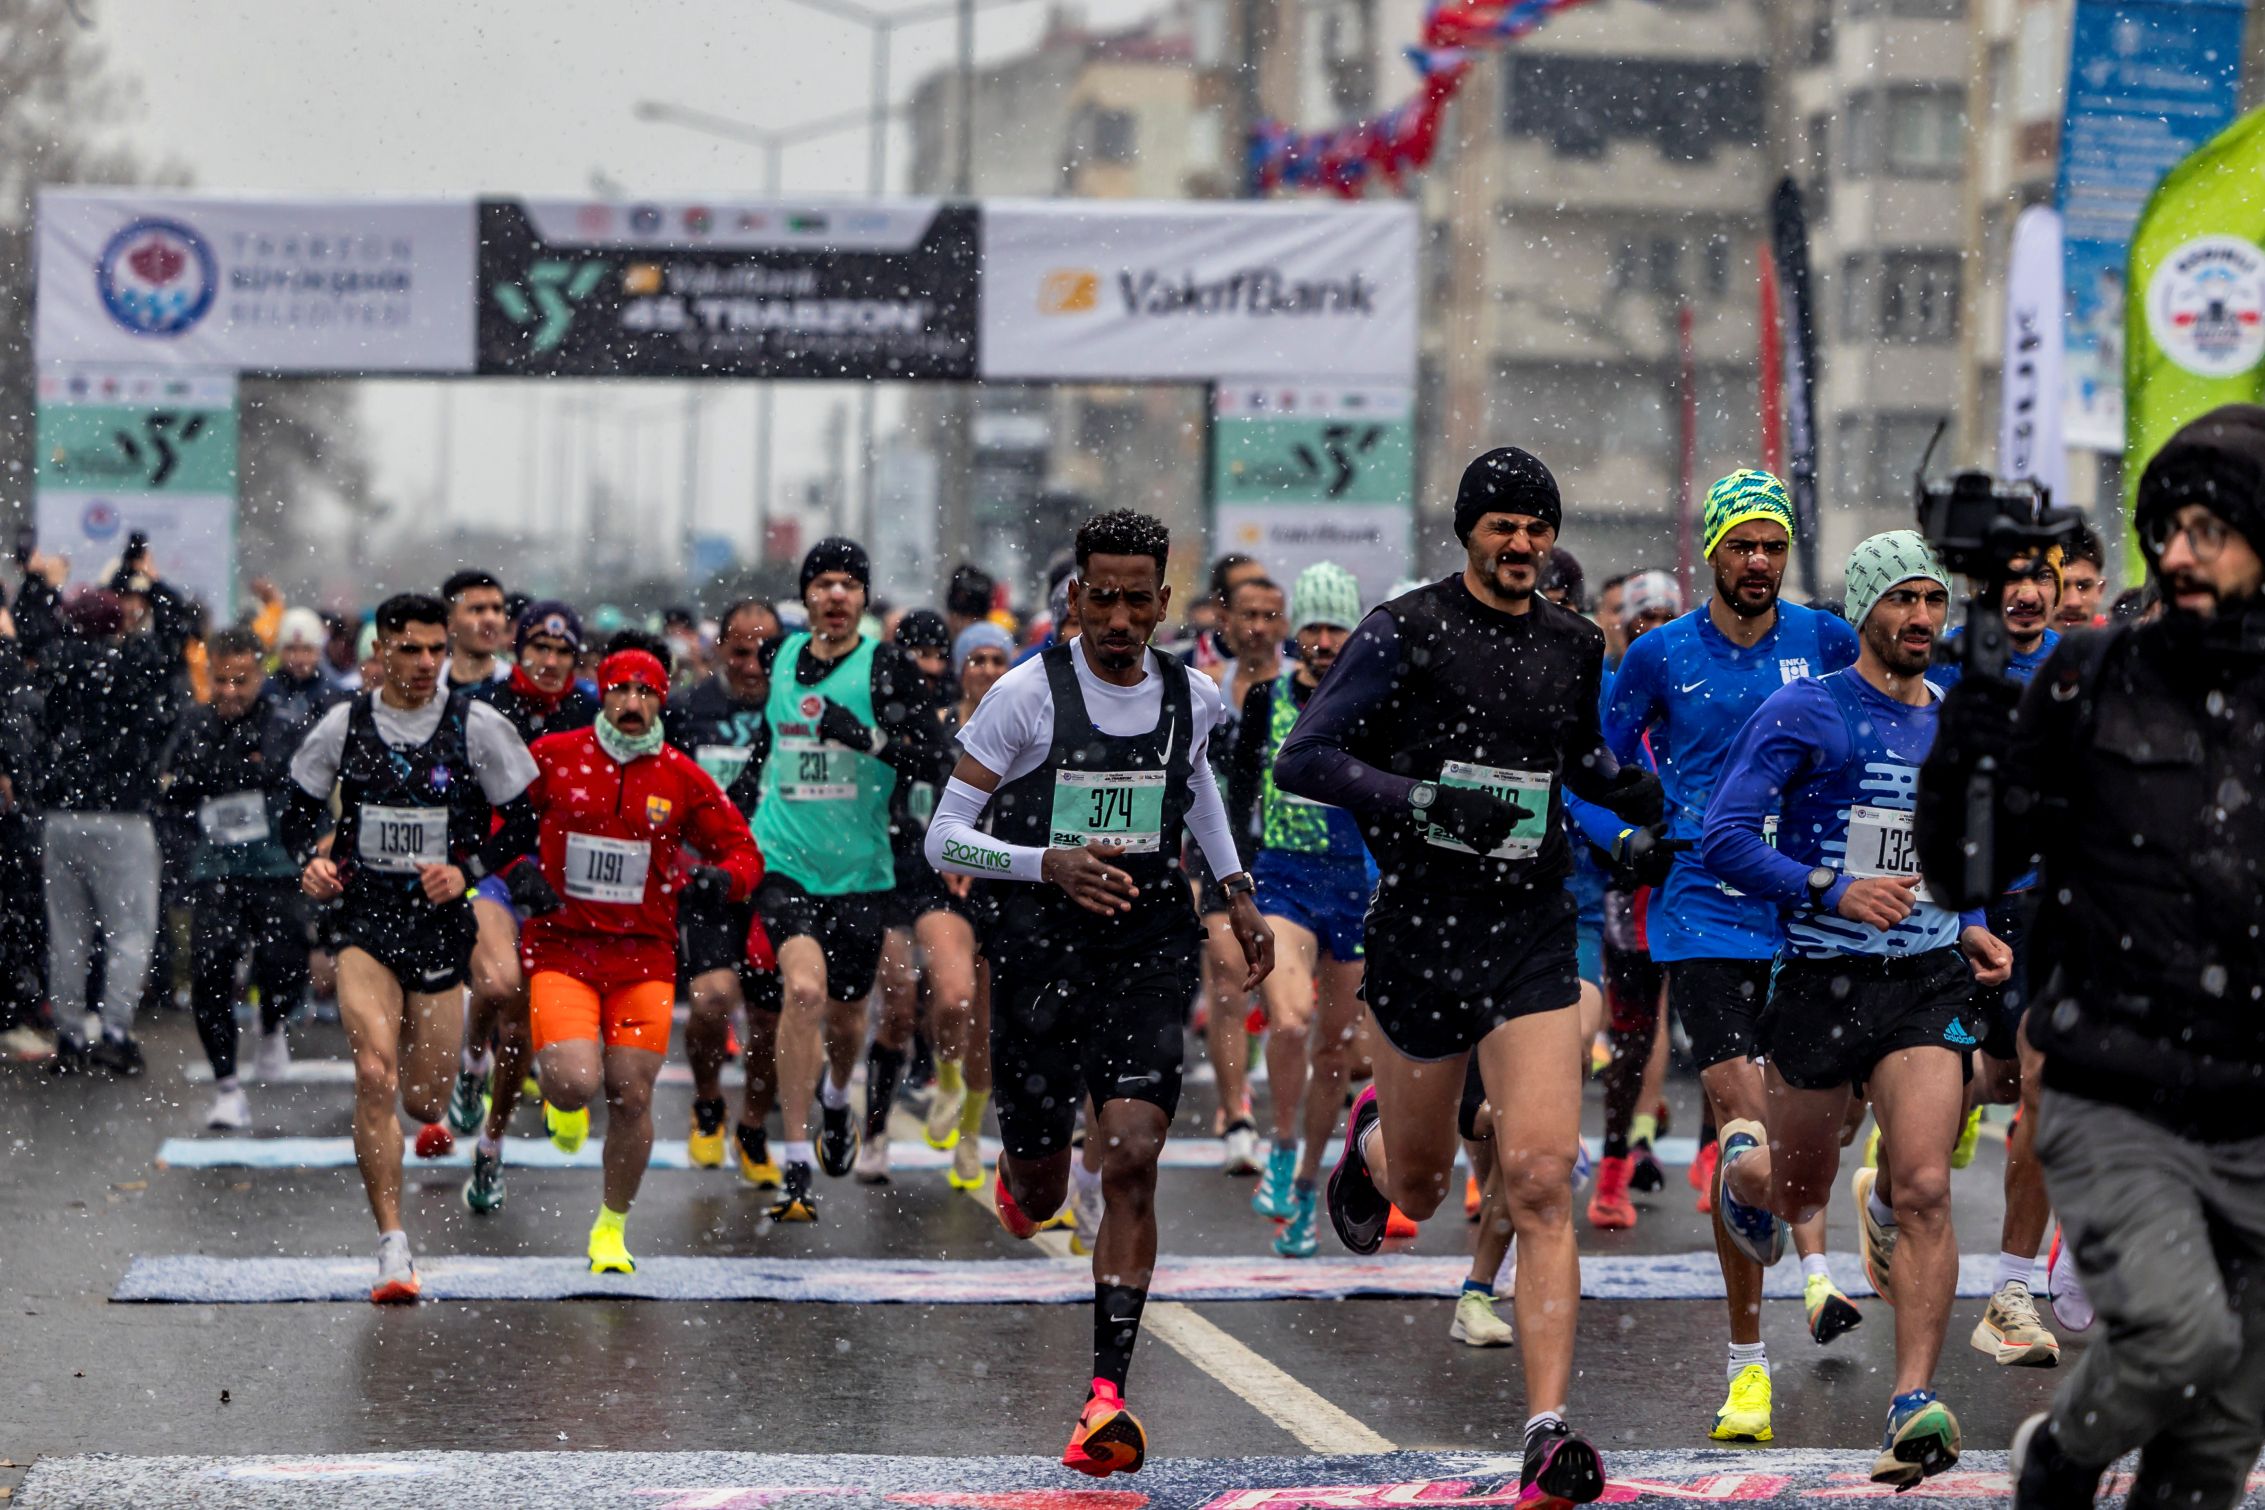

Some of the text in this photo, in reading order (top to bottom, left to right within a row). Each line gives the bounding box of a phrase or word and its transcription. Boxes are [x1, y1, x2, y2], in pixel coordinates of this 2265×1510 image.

[1779, 657, 1807, 667] ENKA
[799, 752, 828, 782] 231
[1088, 787, 1133, 828] 374
[380, 821, 423, 854] 1330
[1053, 832, 1083, 843] 21K
[1876, 827, 1922, 873] 132
[587, 849, 624, 885] 1191
[1943, 1033, 1976, 1044] adidas
